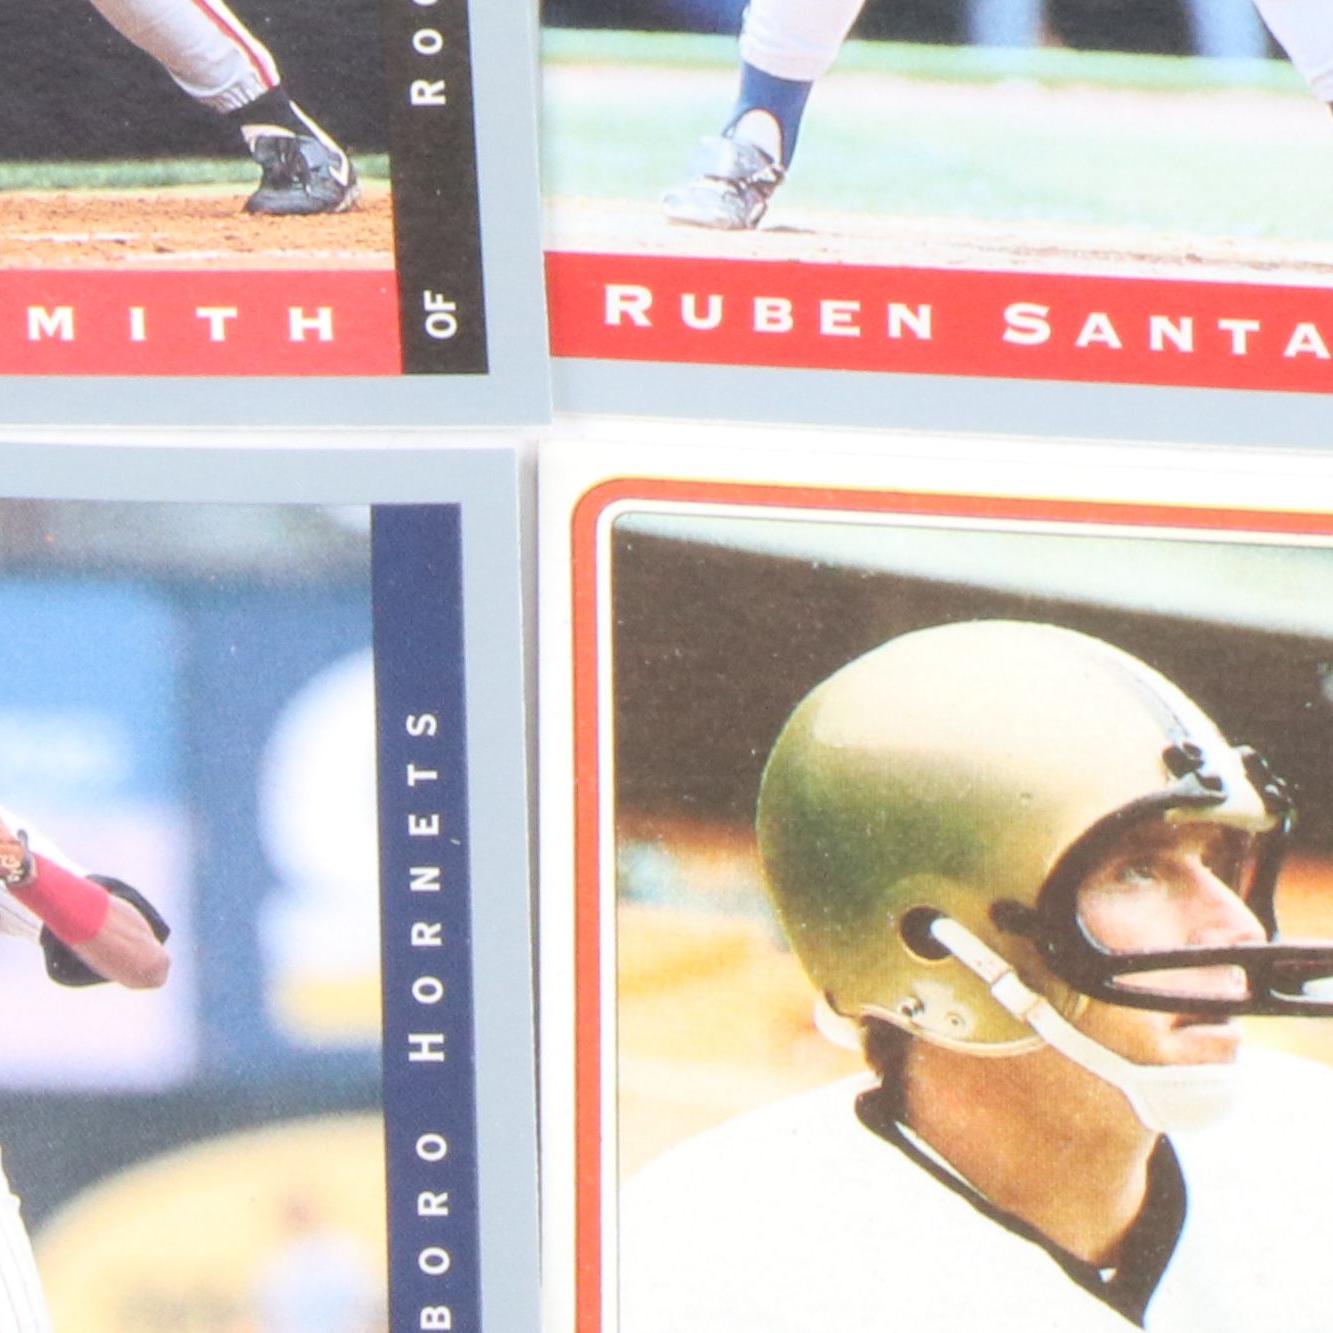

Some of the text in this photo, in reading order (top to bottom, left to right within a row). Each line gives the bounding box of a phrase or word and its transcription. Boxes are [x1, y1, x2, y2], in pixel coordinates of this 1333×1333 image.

[410, 0, 446, 106] RO
[425, 291, 457, 339] OF
[604, 284, 1332, 360] RUBEN SANTA
[406, 713, 445, 1062] HORNETS
